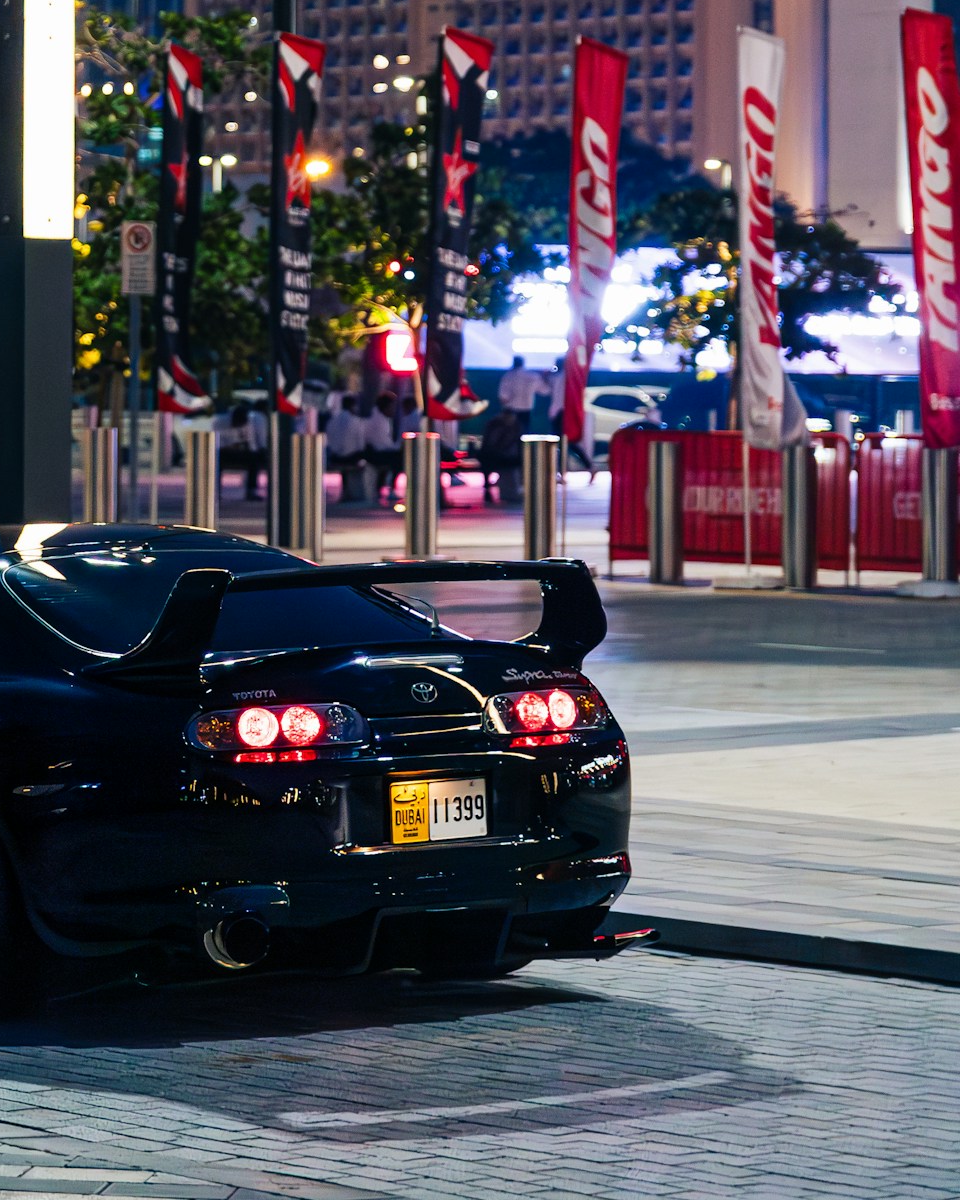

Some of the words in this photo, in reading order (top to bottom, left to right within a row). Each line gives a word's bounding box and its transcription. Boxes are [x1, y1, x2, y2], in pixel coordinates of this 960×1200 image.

[232, 689, 277, 700] TOYOTA
[395, 807, 425, 826] DUBAI
[434, 794, 485, 824] 11399
